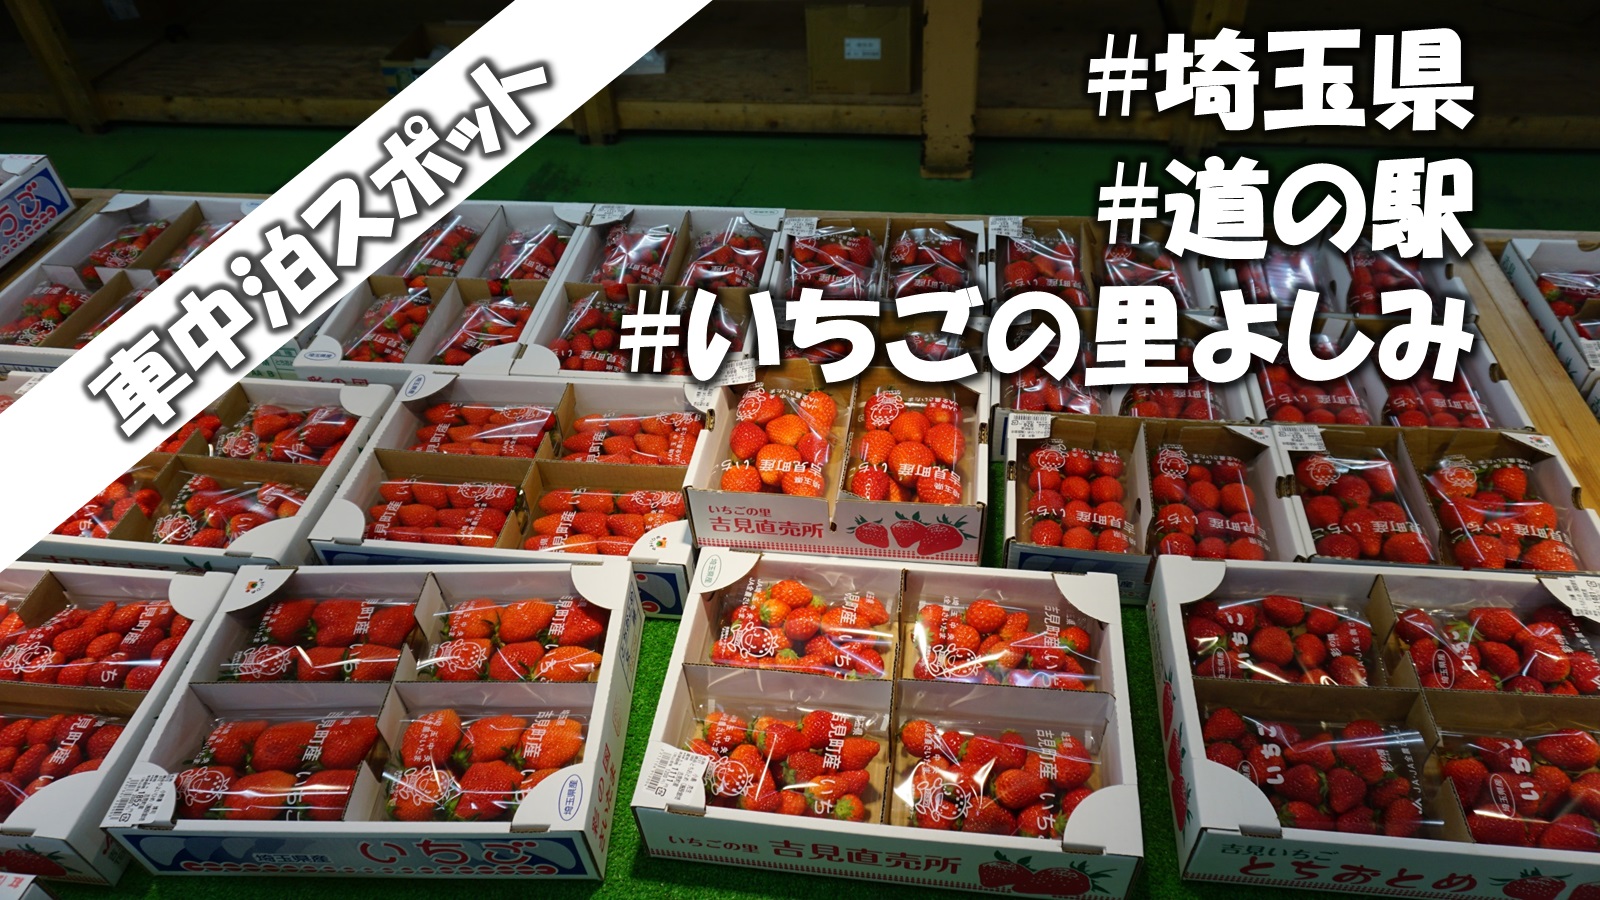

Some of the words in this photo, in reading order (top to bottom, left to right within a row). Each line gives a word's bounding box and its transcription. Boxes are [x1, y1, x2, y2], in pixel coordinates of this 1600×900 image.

[760, 459, 824, 477] 吉見町産
[898, 463, 961, 487] 吉見町産
[709, 505, 772, 518] いちごの里
[709, 517, 825, 539] 吉見直売所
[1076, 510, 1135, 534] 吉見町産
[121, 602, 160, 645] 見町産
[548, 596, 575, 636] 見町産
[1226, 611, 1253, 670] いちご
[1437, 653, 1450, 685] 埼玉県産
[822, 712, 850, 769] 吉見町産
[1036, 728, 1059, 780] 吉見町産
[1257, 724, 1285, 785] いちご
[1501, 739, 1541, 801] いちご
[564, 779, 579, 816] 埼玉県産
[1493, 779, 1511, 813] 埼玉県産
[1036, 792, 1057, 838] いち
[358, 838, 539, 866] いちご
[668, 835, 761, 855] いちごの里
[768, 839, 962, 875] 吉見直売所
[1220, 842, 1341, 862] 吉見いちご
[1239, 855, 1478, 892] とちおとめ
